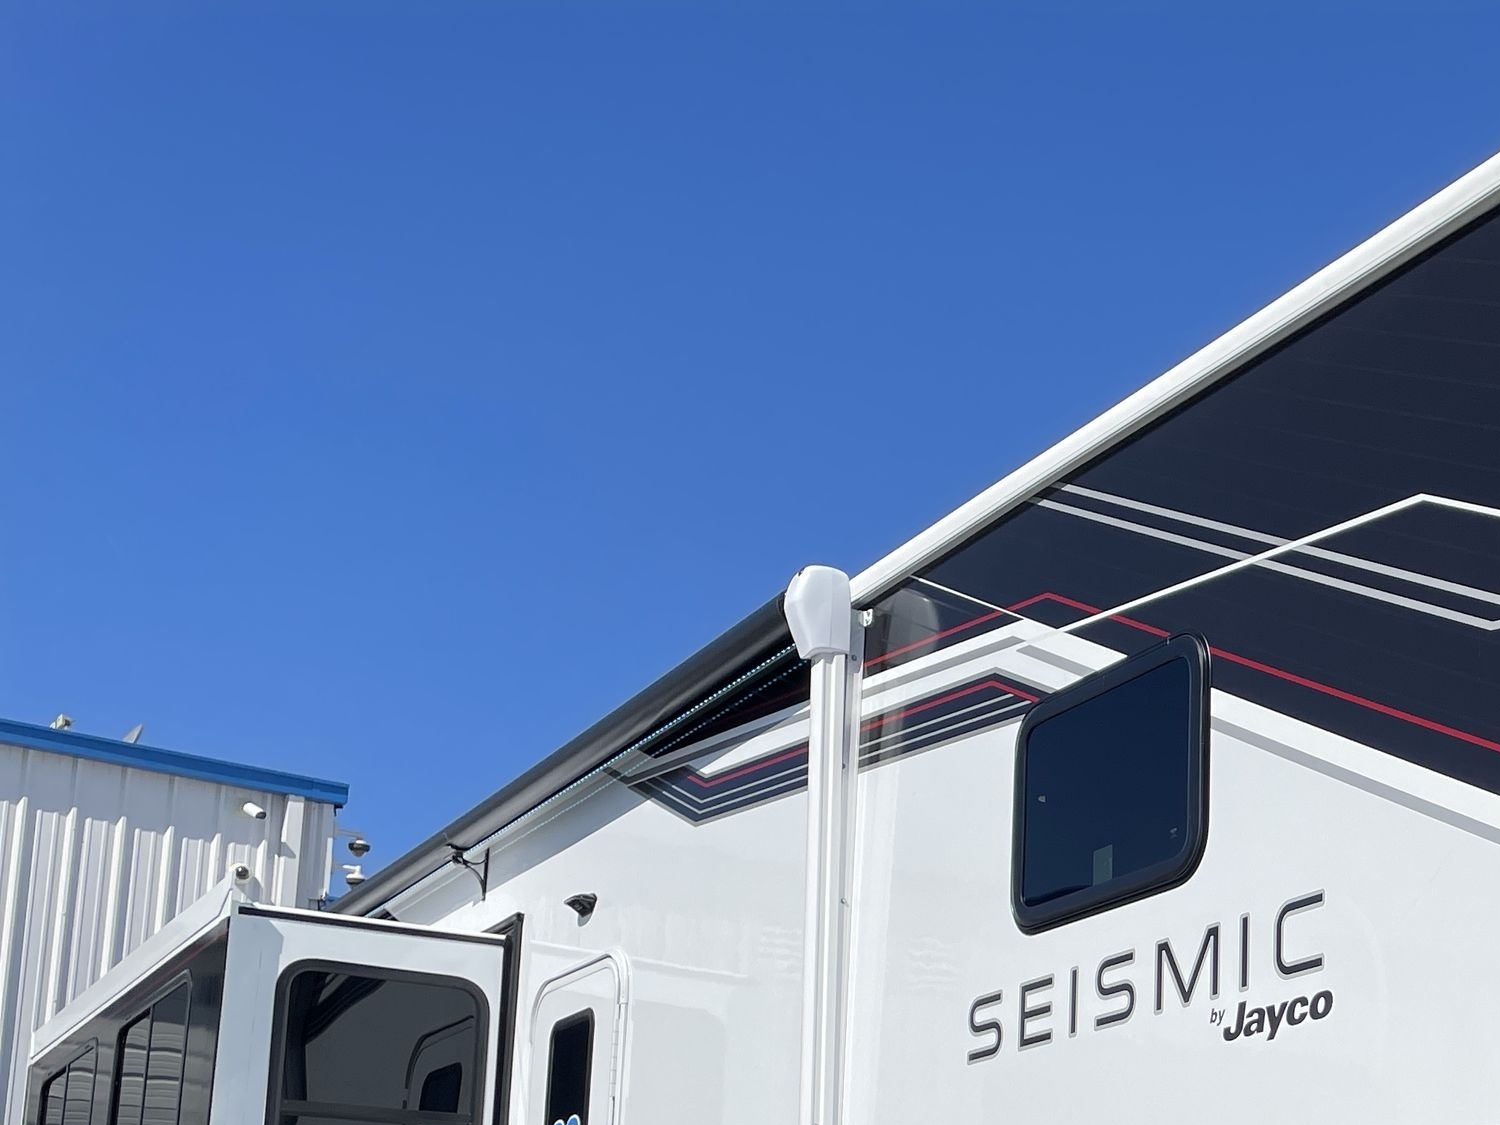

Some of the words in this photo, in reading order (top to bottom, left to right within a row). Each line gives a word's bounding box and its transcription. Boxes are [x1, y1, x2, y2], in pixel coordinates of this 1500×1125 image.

[966, 888, 1326, 1066] SEISMIC
[1209, 1007, 1226, 1026] by
[1223, 989, 1334, 1042] Jayco
